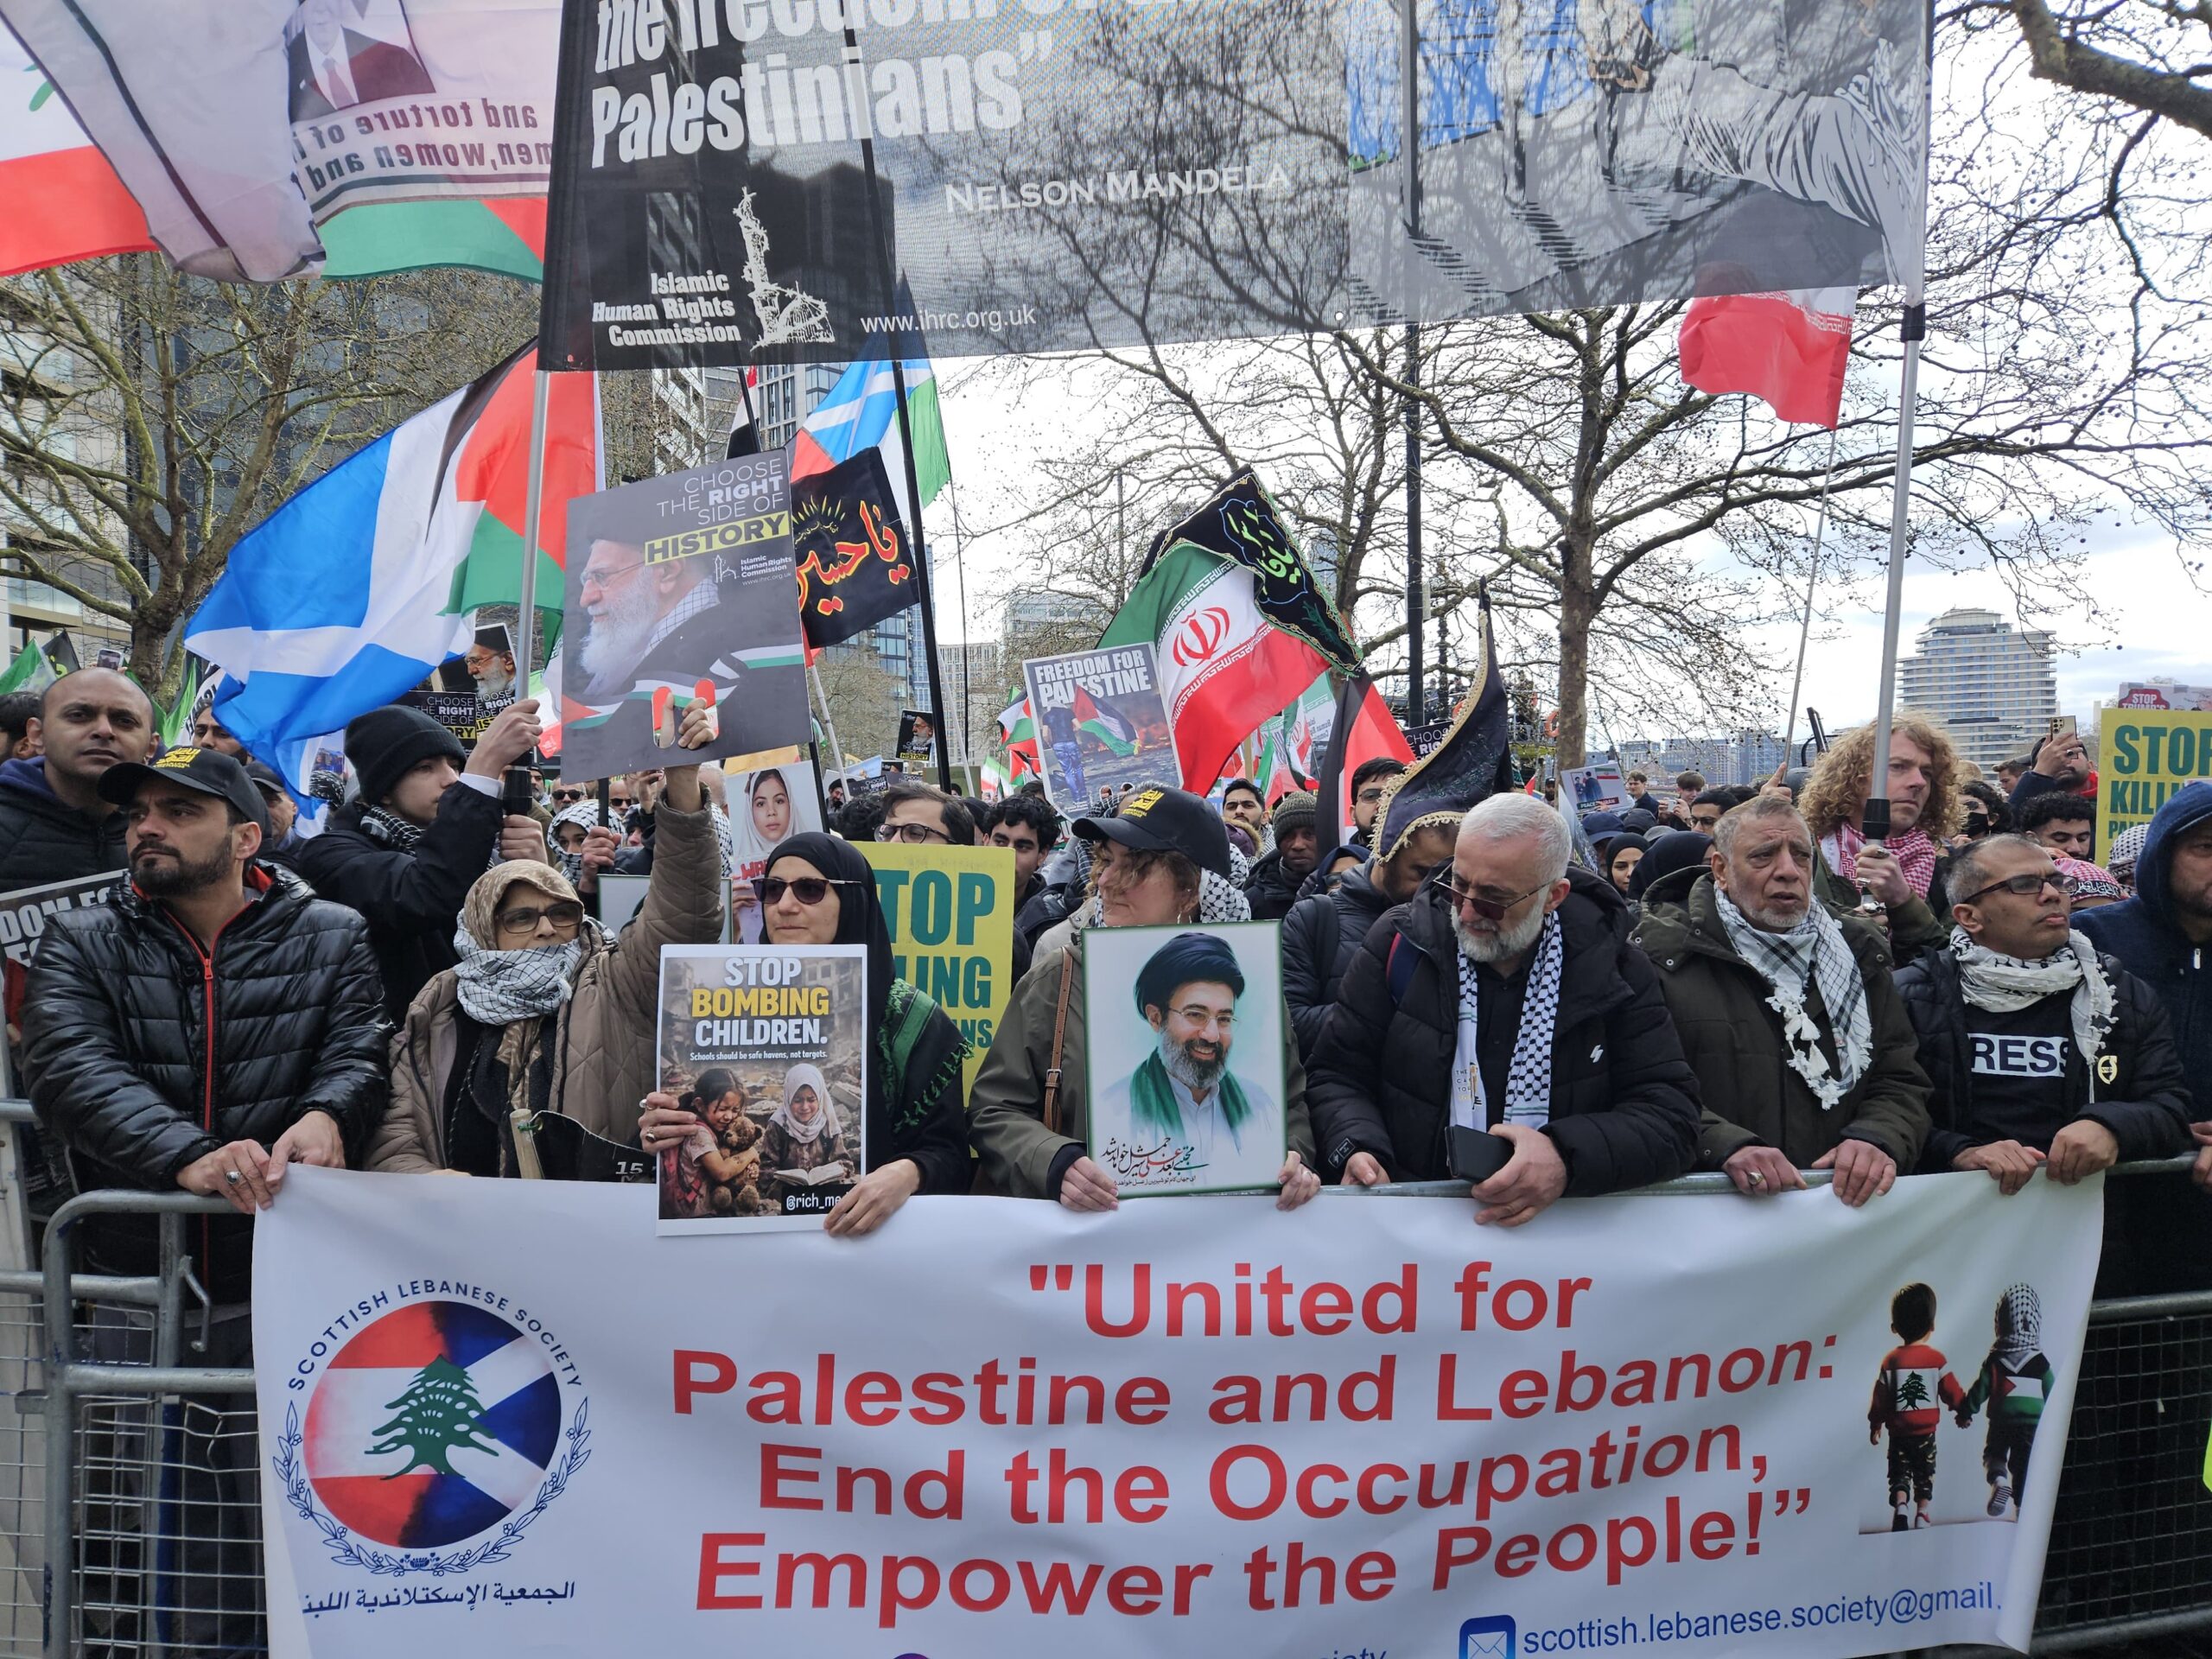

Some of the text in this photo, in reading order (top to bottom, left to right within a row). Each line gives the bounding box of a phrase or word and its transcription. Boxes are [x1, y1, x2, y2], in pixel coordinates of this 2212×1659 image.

[945, 162, 1292, 213] NELSON MANDELA
[651, 270, 729, 295] Islamic
[592, 296, 735, 323] Human Rights
[860, 304, 1037, 334] www.ihrc.org.uk
[608, 321, 741, 346] Commission
[684, 458, 781, 493] CHOOSE
[657, 475, 783, 517] THE RIGHT
[698, 492, 784, 525] SIDE OF
[647, 513, 785, 563] HISTORY
[741, 555, 766, 565] Islamic
[741, 556, 792, 571] Human Rights
[741, 564, 787, 577] Commission
[1034, 650, 1146, 683] FREEDOM FOR
[427, 696, 474, 706] CHOOSE
[438, 706, 474, 715] RIGHT
[475, 690, 512, 702] HOOSE
[2132, 693, 2157, 703] STOP
[433, 715, 456, 724] SIDE
[873, 869, 995, 946] TOP
[724, 957, 801, 986] STOP
[691, 988, 830, 1018] BOMBING
[696, 1018, 828, 1047] CHILDREN.
[690, 1052, 715, 1061] Schools
[715, 1052, 737, 1060] should
[764, 1051, 788, 1059] havens,
[803, 1050, 828, 1059] targets.
[615, 1161, 644, 1175] 15
[786, 1192, 842, 1211] @rich_me
[1454, 1261, 1592, 1332] for
[289, 1280, 582, 1390] SCOTTISH LEBANESE SOCIETY
[673, 1335, 1837, 1427] Palestine and Lebanon:
[760, 1424, 1768, 1523] End the Occupation,
[493, 1581, 575, 1605] الجمعية
[696, 1532, 1213, 1629] Empower
[1243, 1541, 1396, 1611] the
